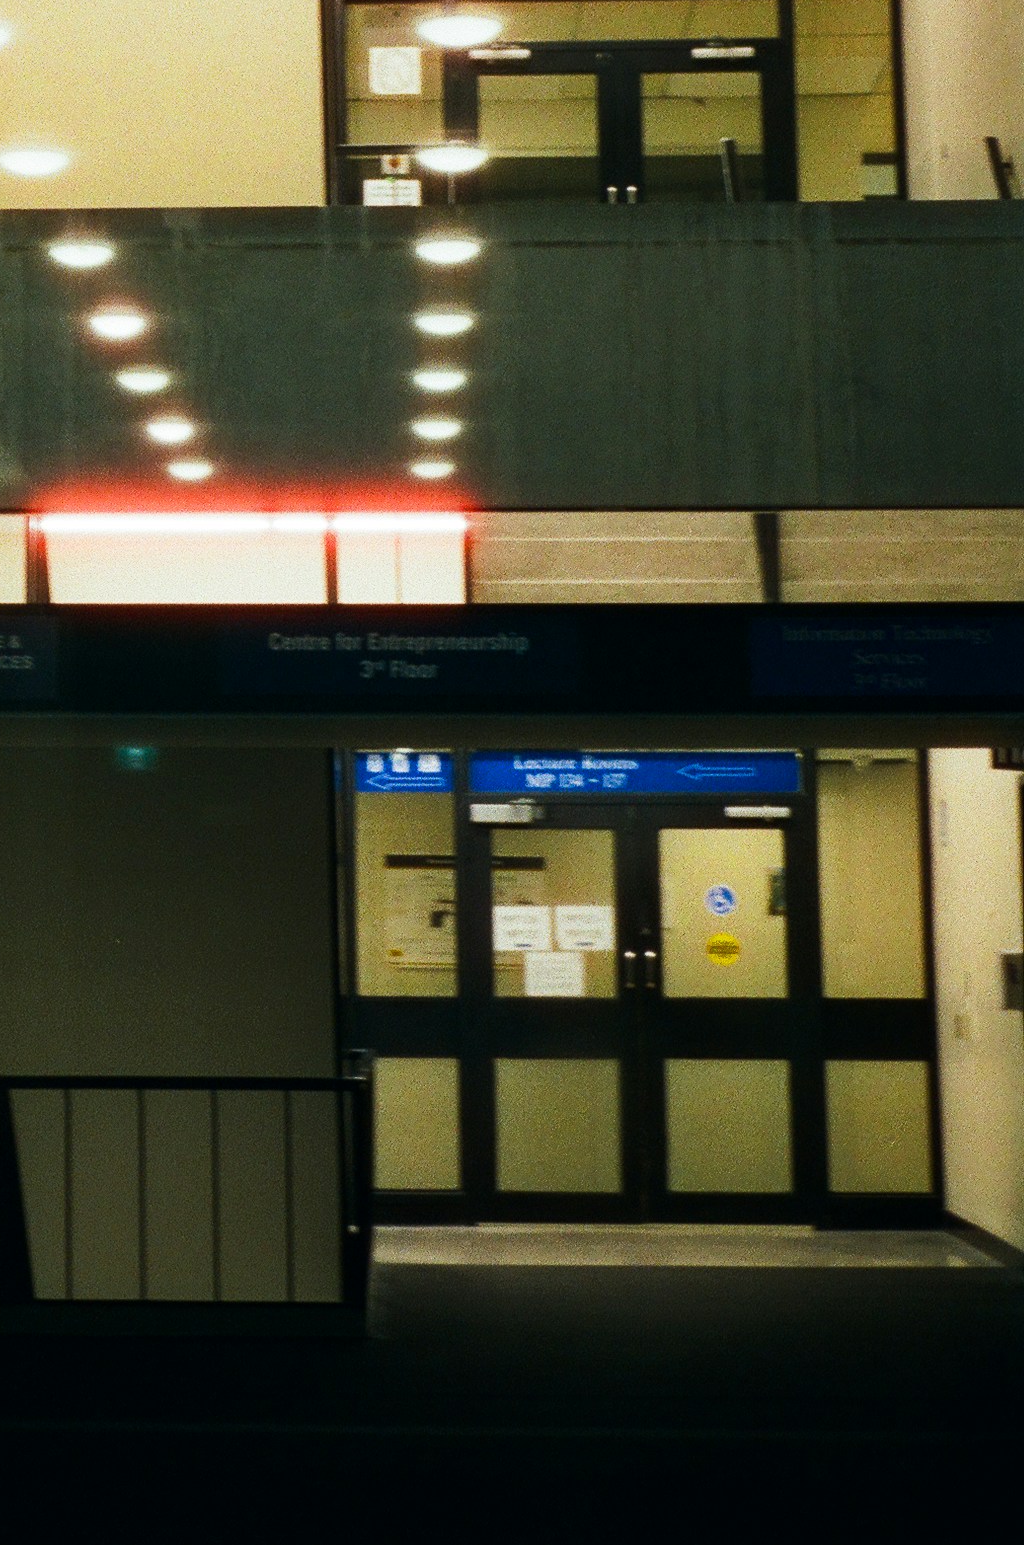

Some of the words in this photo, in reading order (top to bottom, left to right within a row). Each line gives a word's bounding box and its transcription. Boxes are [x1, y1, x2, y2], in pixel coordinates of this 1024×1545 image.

[8, 634, 22, 648] &
[268, 632, 331, 651] Centre
[335, 631, 362, 651] for
[367, 631, 530, 655] Entrepreneurship
[781, 625, 886, 642] Information
[890, 624, 994, 645] Technology
[389, 659, 439, 678] Floor
[879, 672, 926, 690] Floor
[513, 755, 577, 770] Lecture
[581, 755, 639, 770] Rooms
